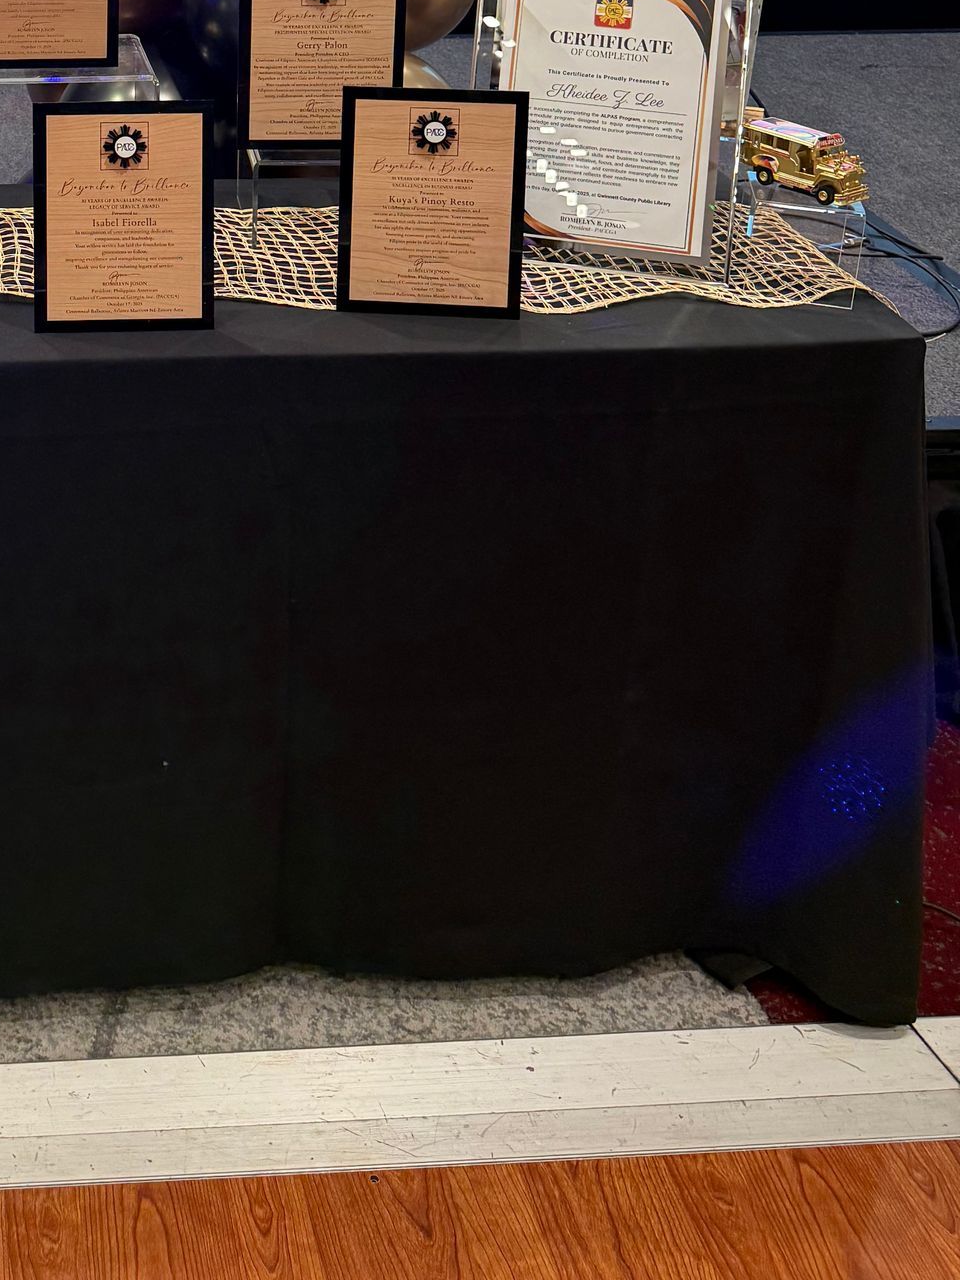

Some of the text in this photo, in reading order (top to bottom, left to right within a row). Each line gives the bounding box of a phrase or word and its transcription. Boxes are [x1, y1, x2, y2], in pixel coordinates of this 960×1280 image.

[297, 42, 321, 50] Gerry
[549, 30, 673, 54] CERTIFICATE
[570, 48, 649, 62] OF COMPLETION
[562, 70, 594, 78] Certificate
[603, 74, 626, 82] Proudly
[628, 77, 659, 85] Presented
[546, 81, 608, 102] Kheidee
[634, 91, 665, 108] Lee
[389, 196, 474, 206] Kuya's Pinoy Resto
[92, 217, 156, 226] Isabel Fiorella
[560, 215, 594, 225] ROMIELYN
[604, 221, 626, 229] JOSON
